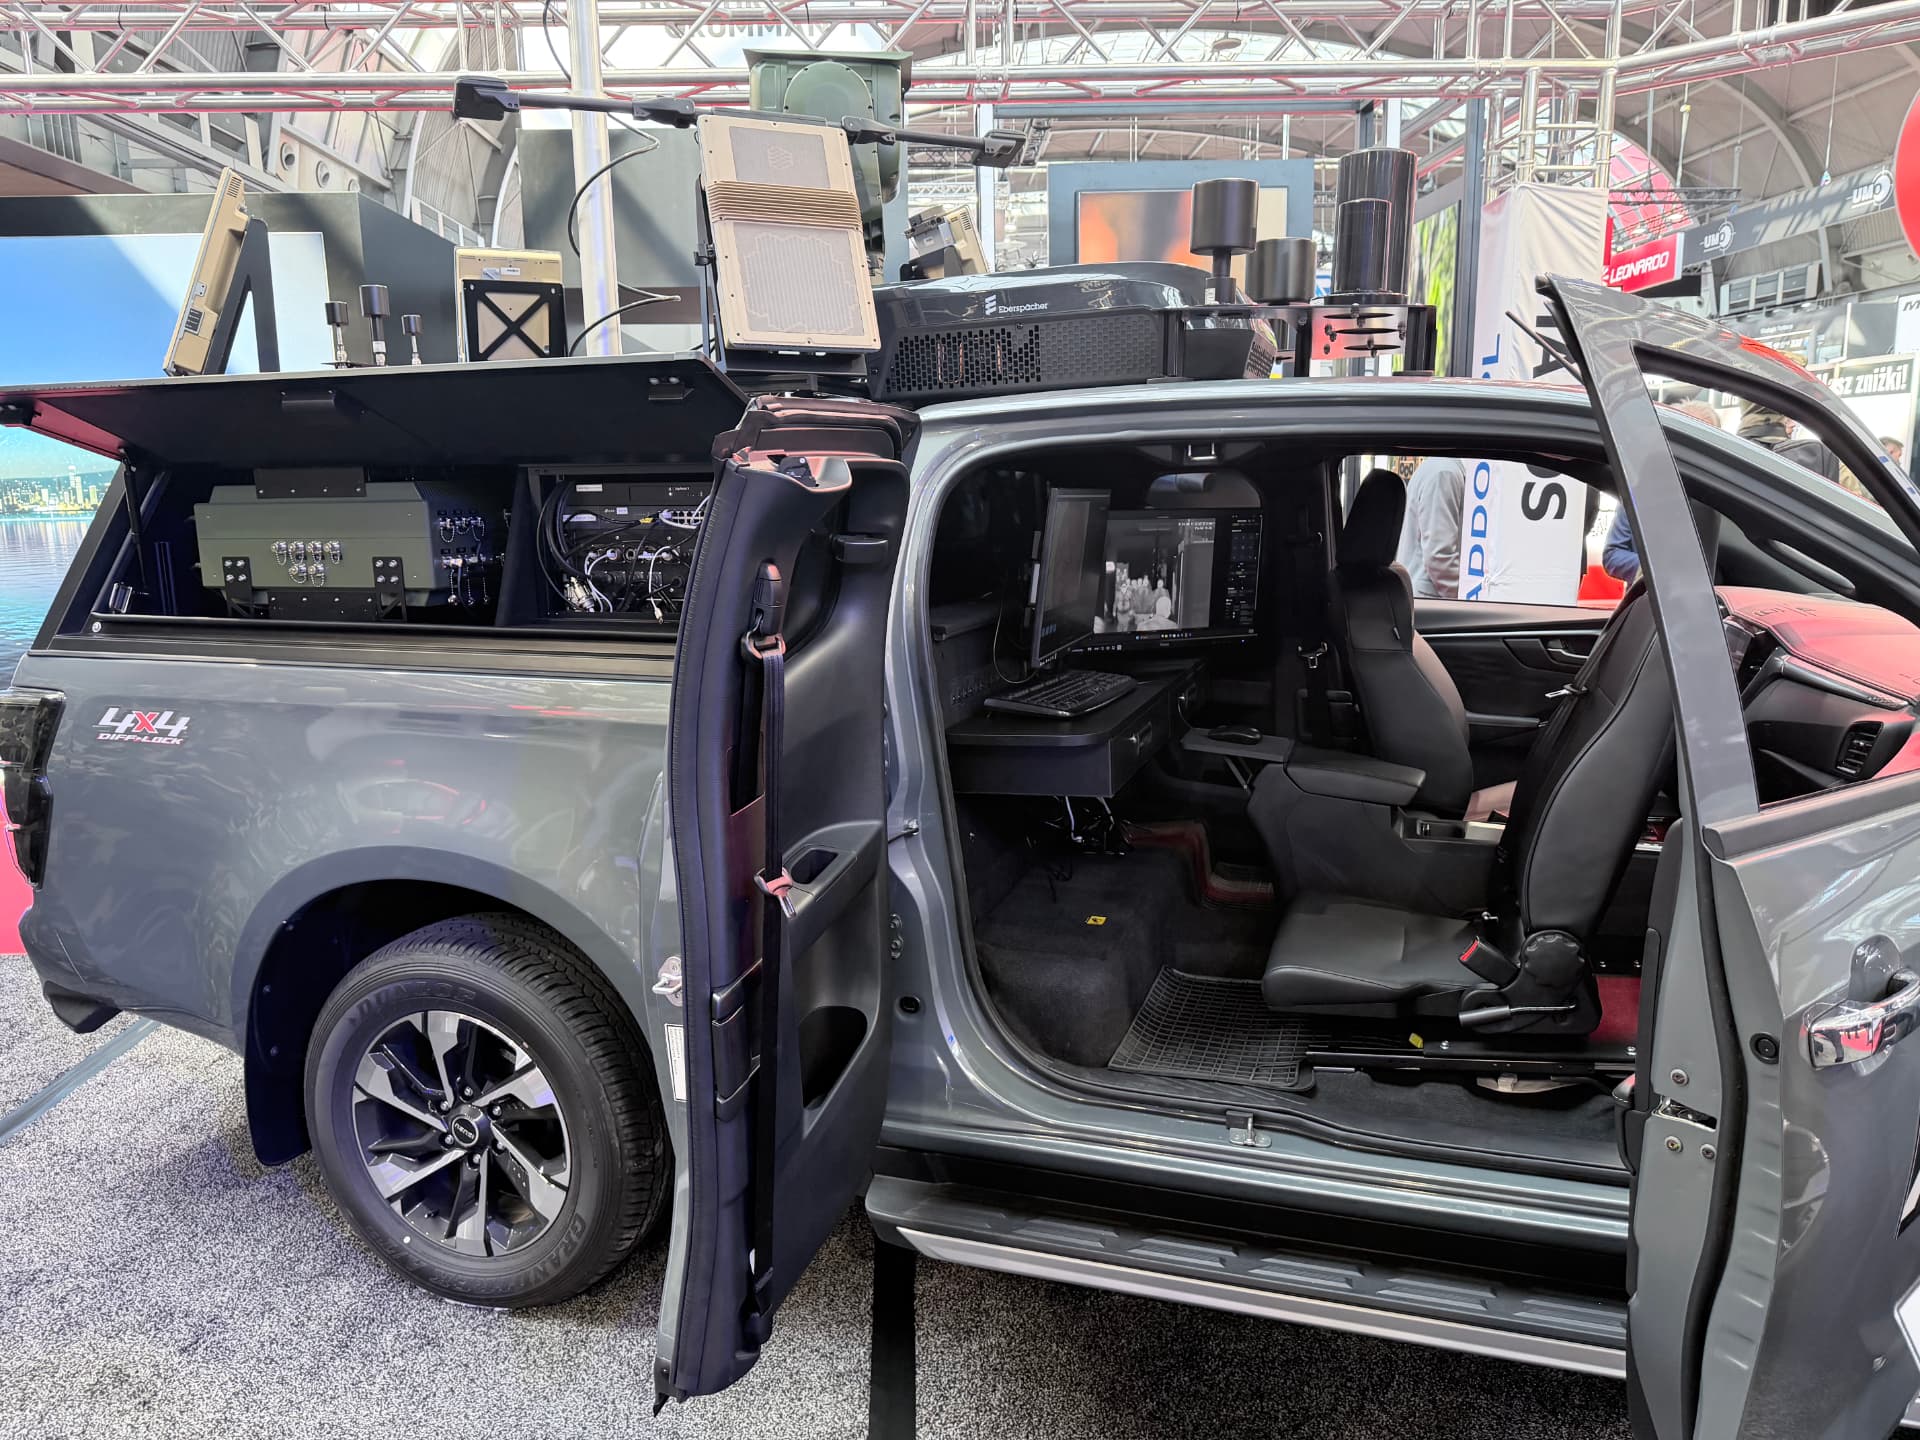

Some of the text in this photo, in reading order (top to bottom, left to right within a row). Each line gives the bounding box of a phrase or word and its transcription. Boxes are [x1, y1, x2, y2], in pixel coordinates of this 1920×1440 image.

[1852, 174, 1892, 204] UMO
[1704, 224, 1733, 249] UMO
[1609, 252, 1670, 284] LEONARDO
[1854, 363, 1909, 395] zniżki!
